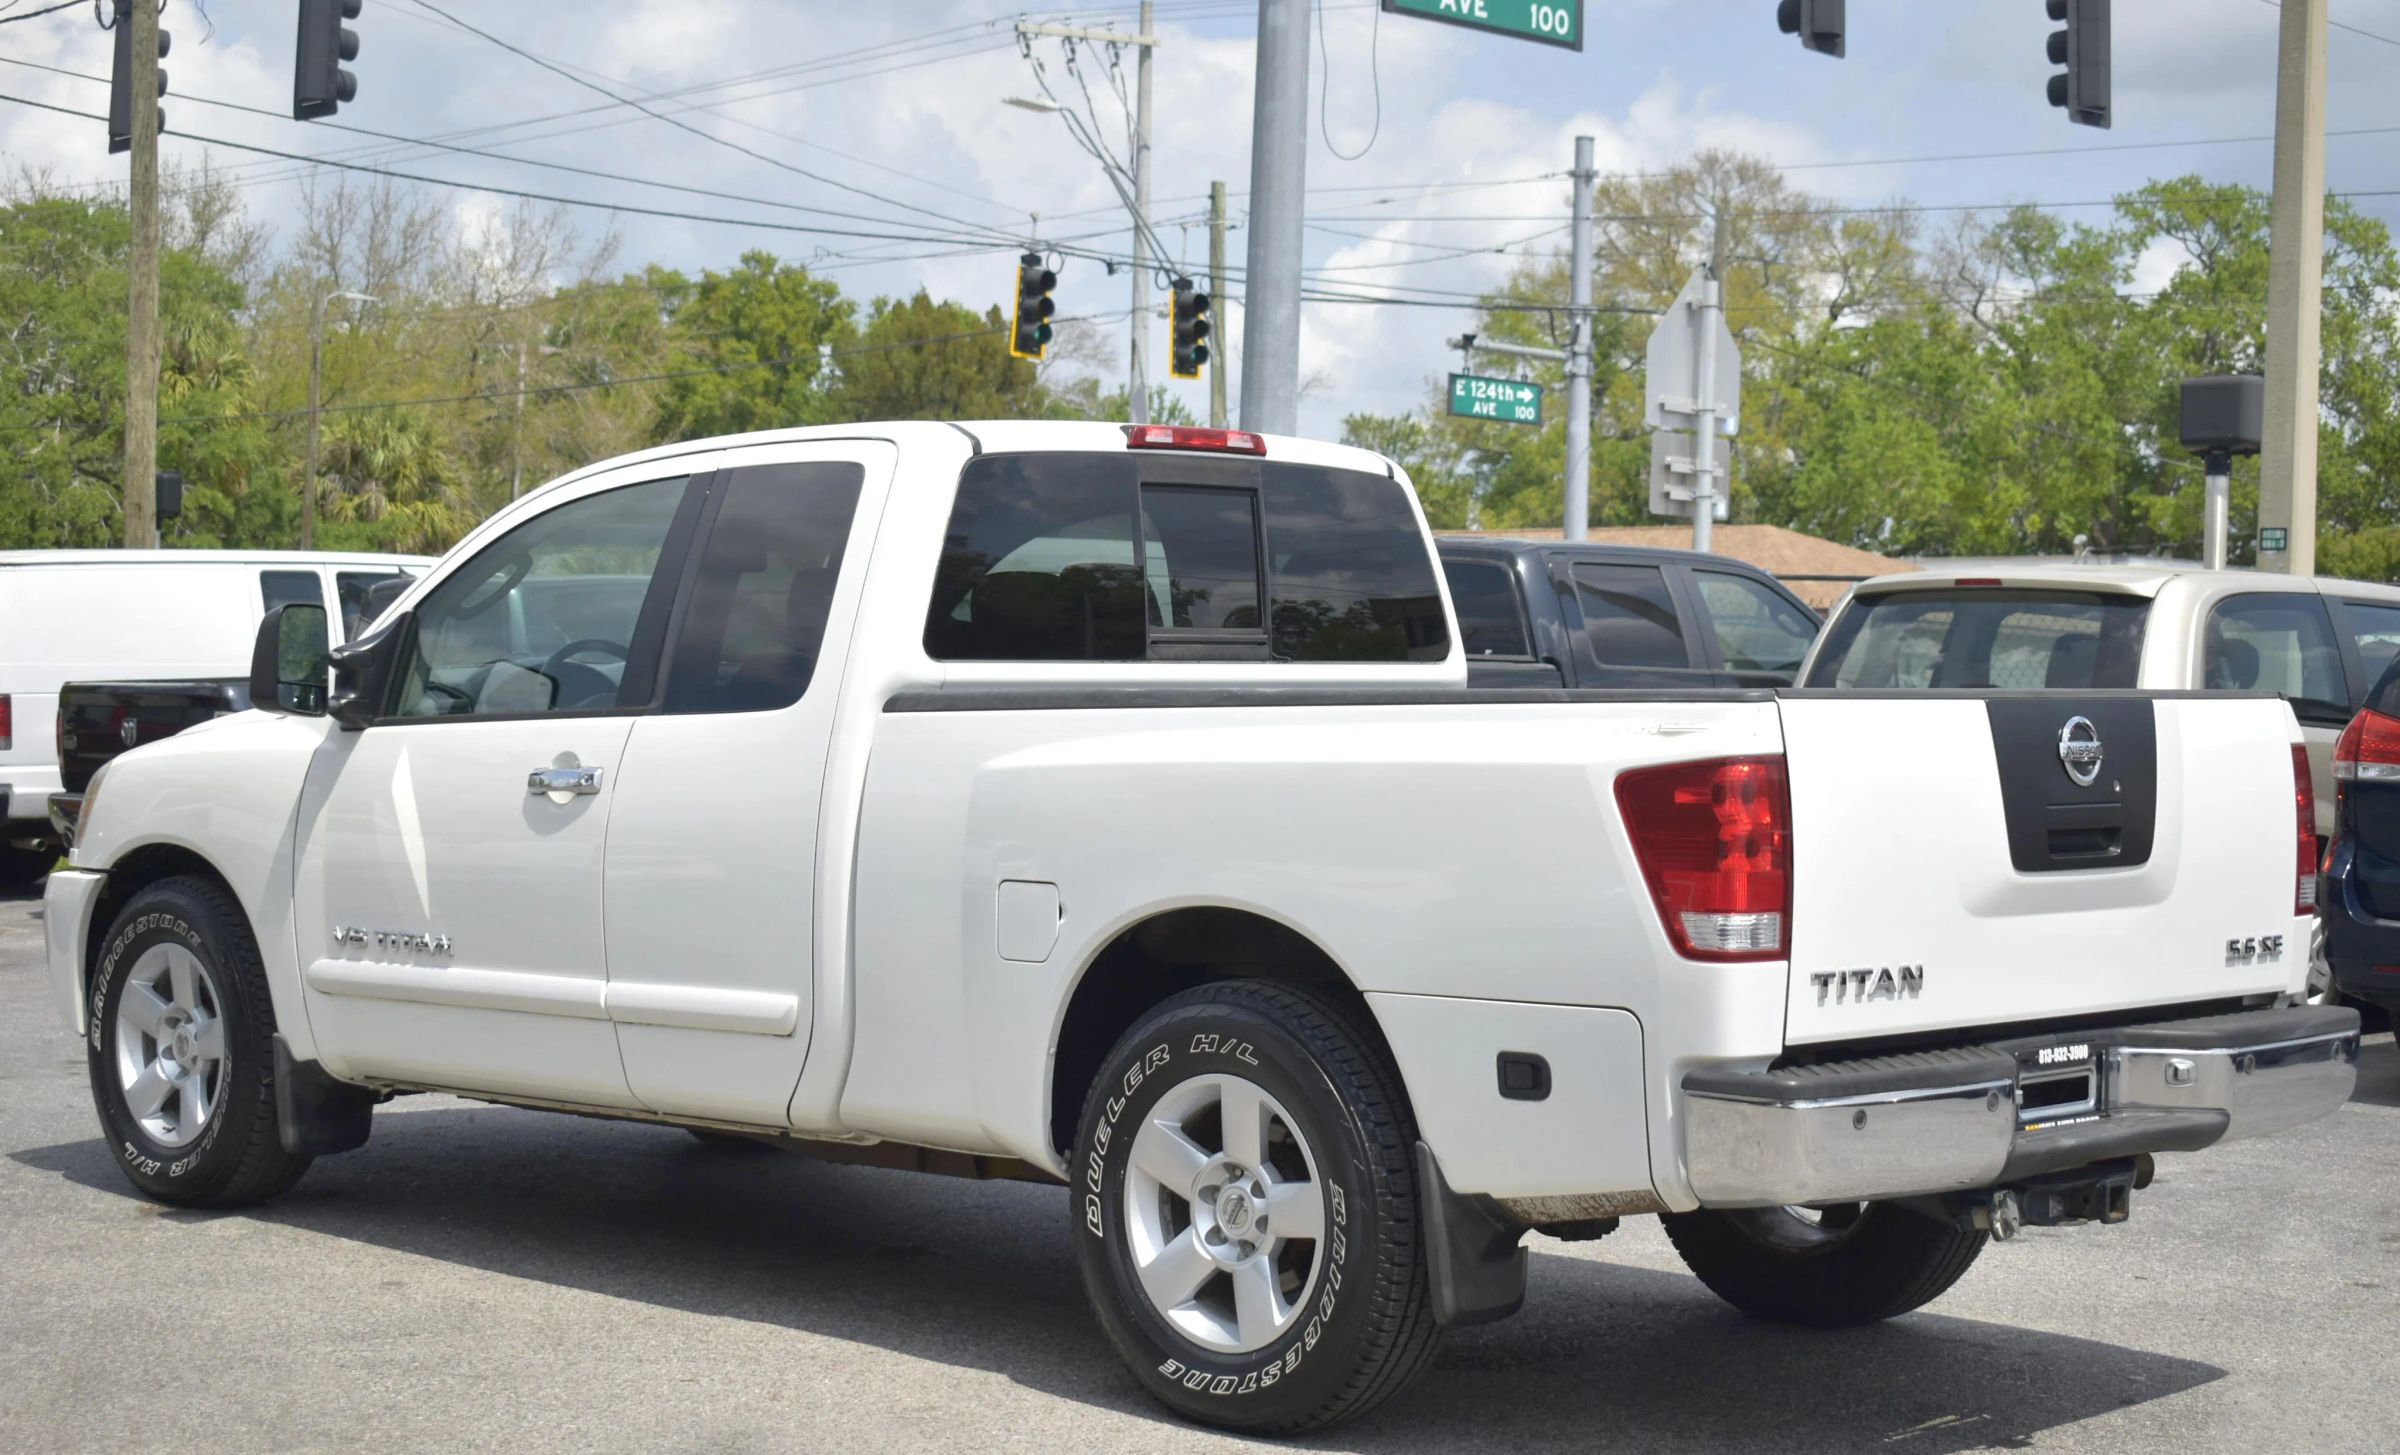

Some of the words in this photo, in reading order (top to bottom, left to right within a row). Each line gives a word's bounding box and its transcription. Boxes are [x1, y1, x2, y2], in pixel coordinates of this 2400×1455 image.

[1531, 3, 1569, 35] 100
[1455, 379, 1466, 396] E
[1471, 380, 1514, 402] 124th
[1472, 401, 1497, 416] AVE
[1515, 405, 1535, 420] 100
[374, 928, 454, 957] TITAN
[1810, 963, 1923, 1000] TITAN
[2038, 1044, 2089, 1065] 813-932-3900
[1087, 1044, 1170, 1238] DUELER
[1190, 1033, 1259, 1066] H/L
[124, 1141, 161, 1175] H/L
[1158, 1177, 1346, 1395] BRIDGESTONE
